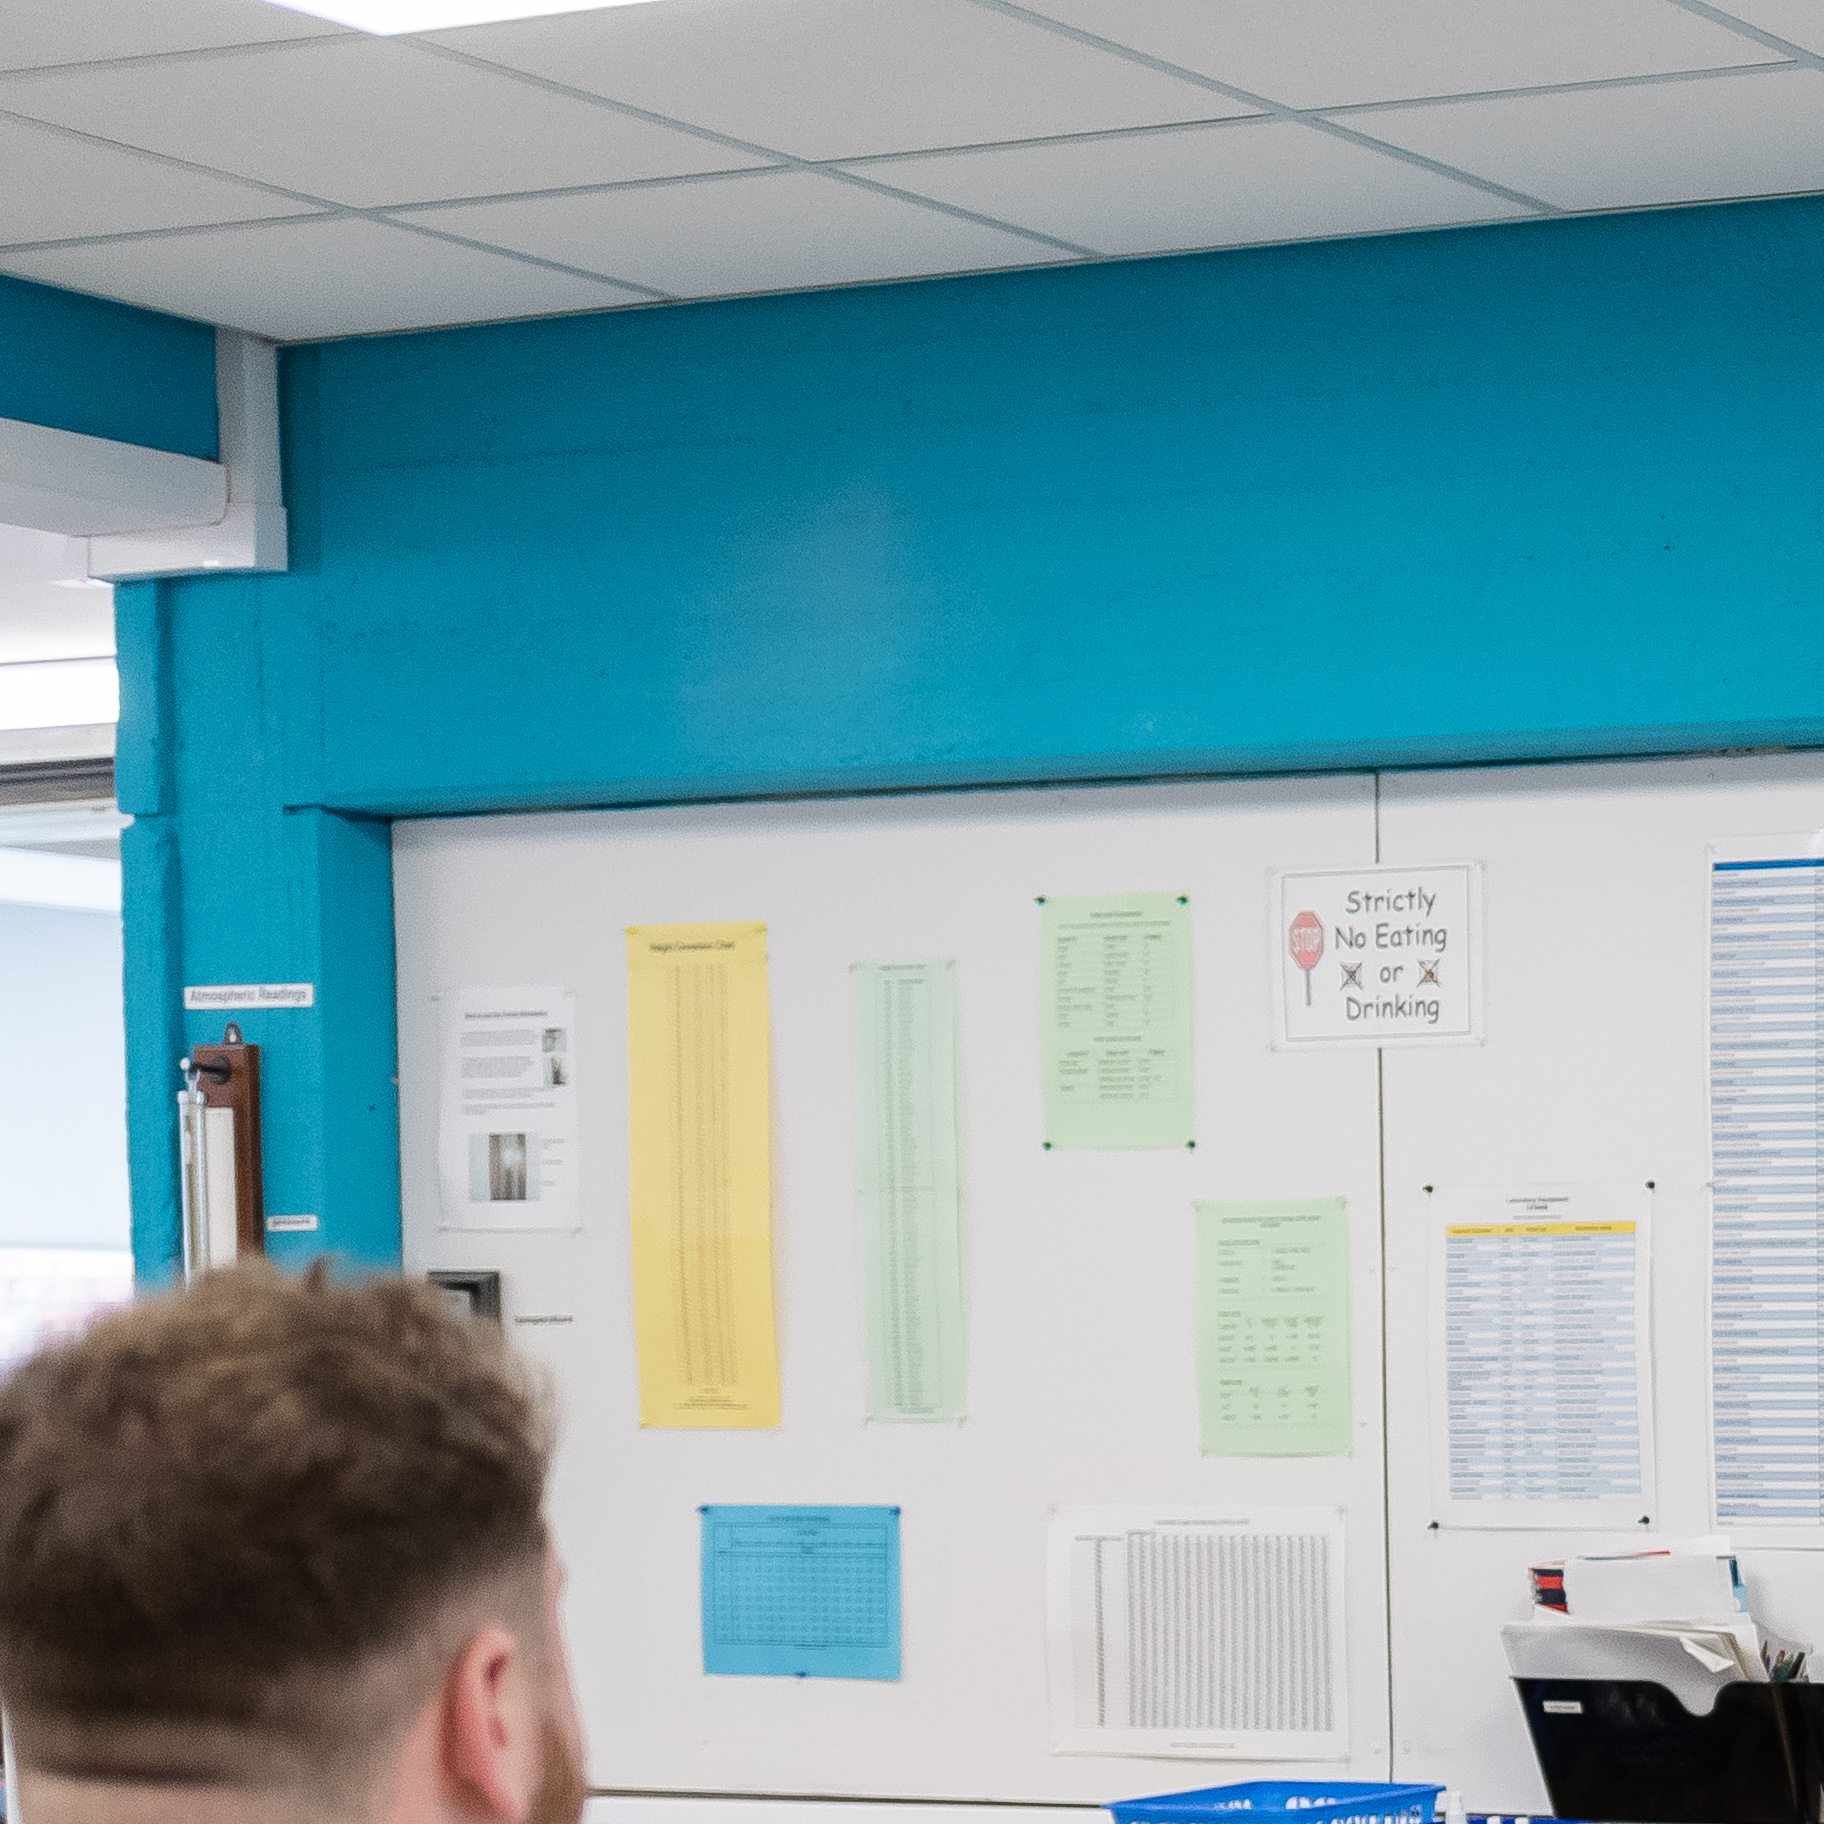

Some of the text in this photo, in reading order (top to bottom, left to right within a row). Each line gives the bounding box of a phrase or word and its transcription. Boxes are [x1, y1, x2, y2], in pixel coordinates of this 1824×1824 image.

[1345, 885, 1437, 918] Strictly
[1335, 921, 1448, 953] No Eating
[1379, 964, 1404, 985] or
[1345, 992, 1441, 1025] Drinking
